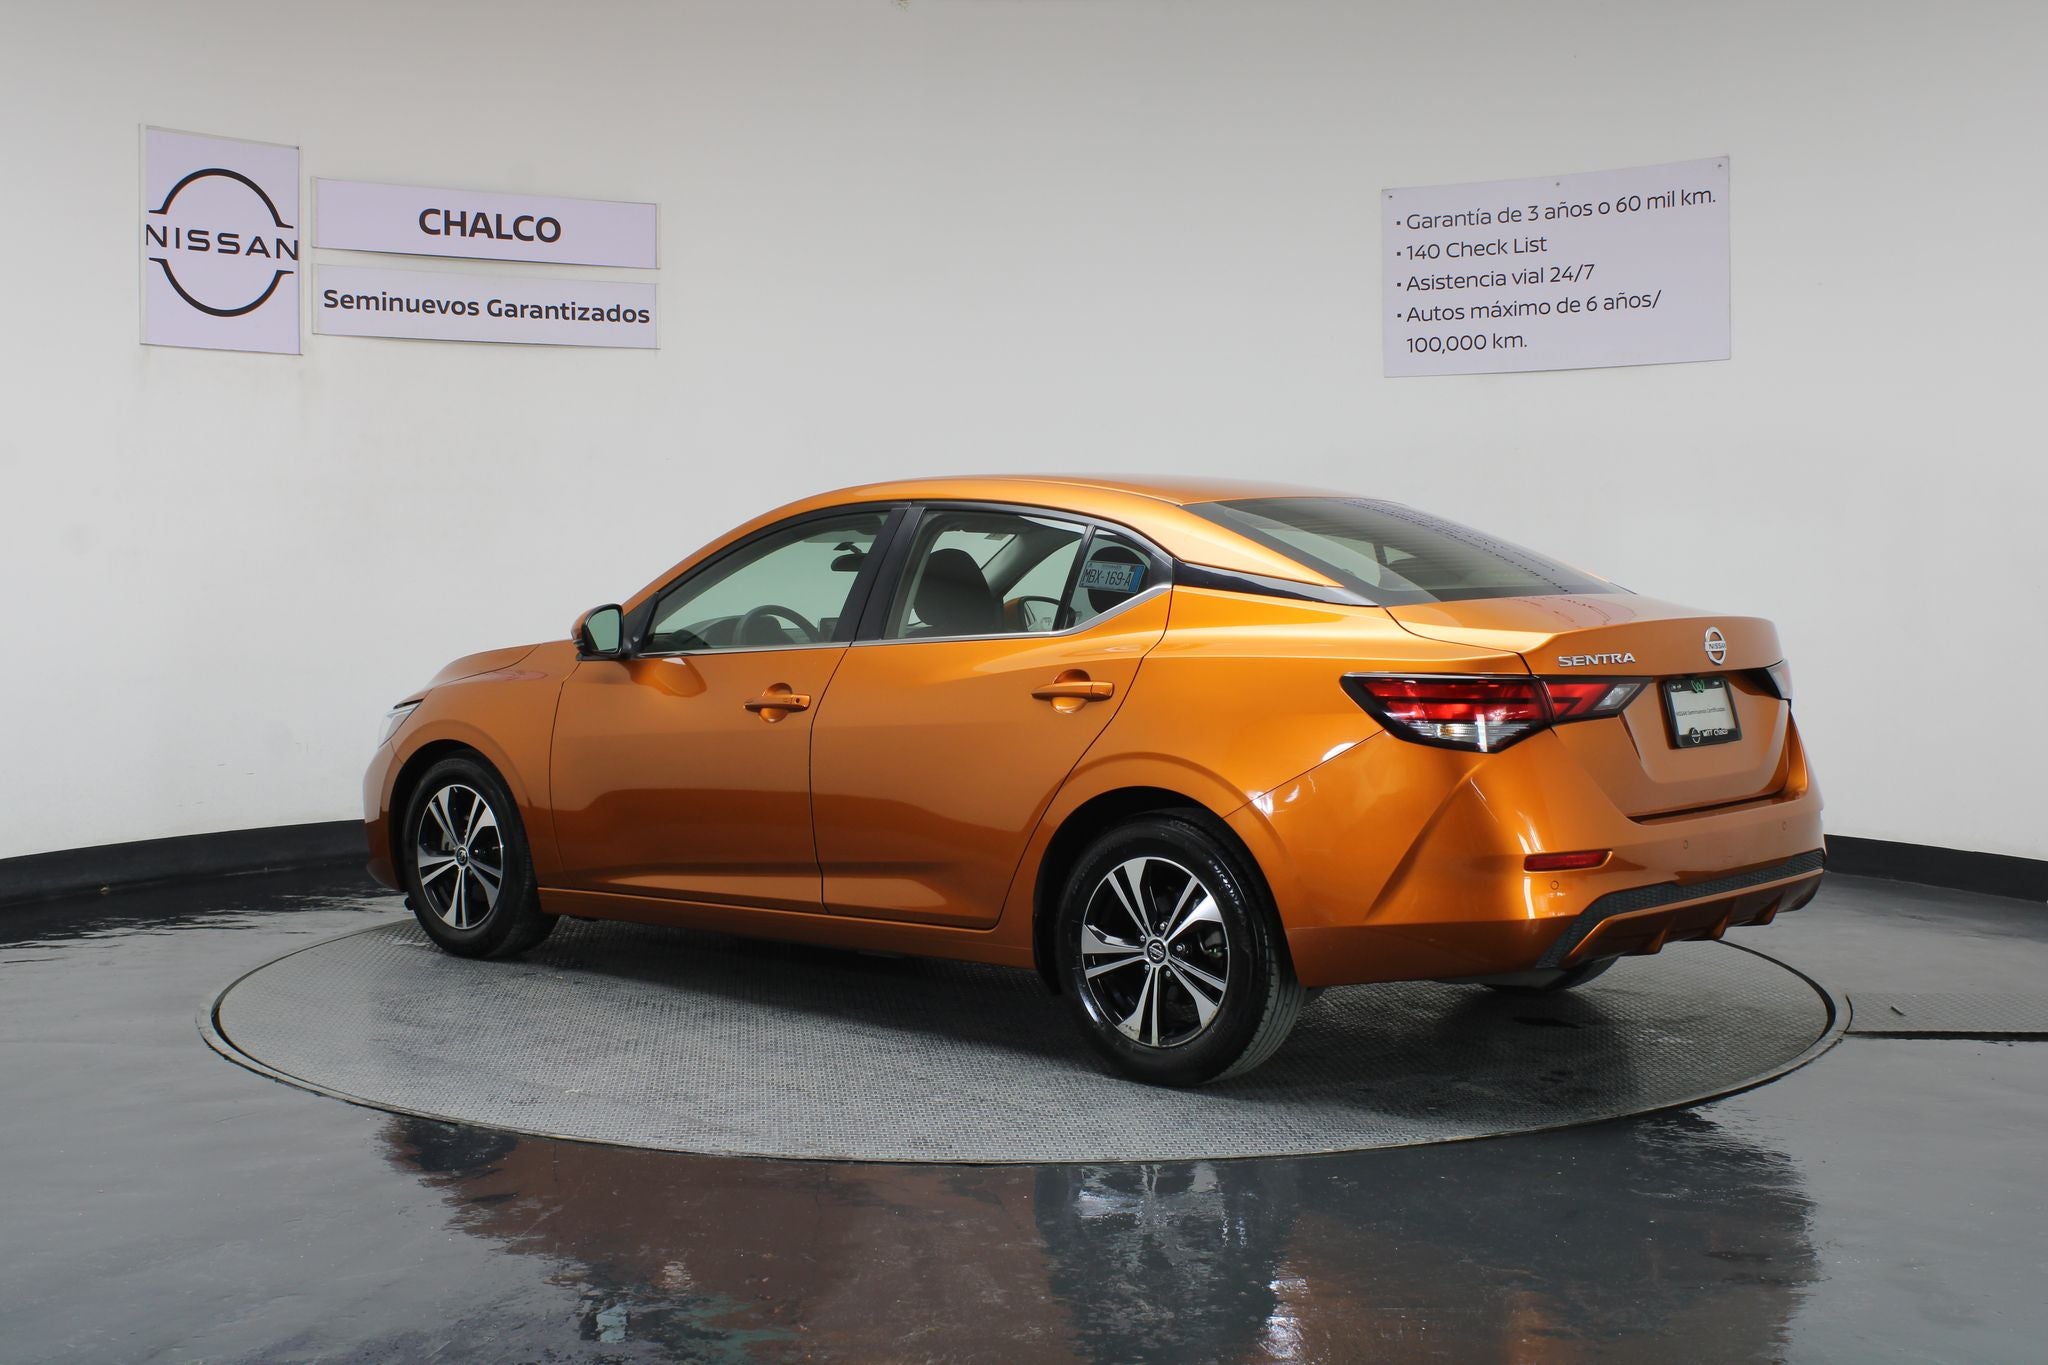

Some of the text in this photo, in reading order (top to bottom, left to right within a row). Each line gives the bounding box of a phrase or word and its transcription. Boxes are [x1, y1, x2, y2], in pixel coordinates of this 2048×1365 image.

[418, 207, 562, 243] CHALCO
[1406, 188, 1717, 230] Garantía de 3 años o 60 mil km.
[145, 223, 299, 261] NISSAN
[1406, 236, 1548, 261] 140 Check List
[1406, 263, 1596, 292] Asistencia vial 24/7
[323, 288, 651, 324] Seminuevos Garantizados
[1406, 289, 1662, 323] Autos máximo de 6 años/
[1406, 332, 1528, 355] 100,000 km.
[1558, 652, 1636, 667] SENTRA
